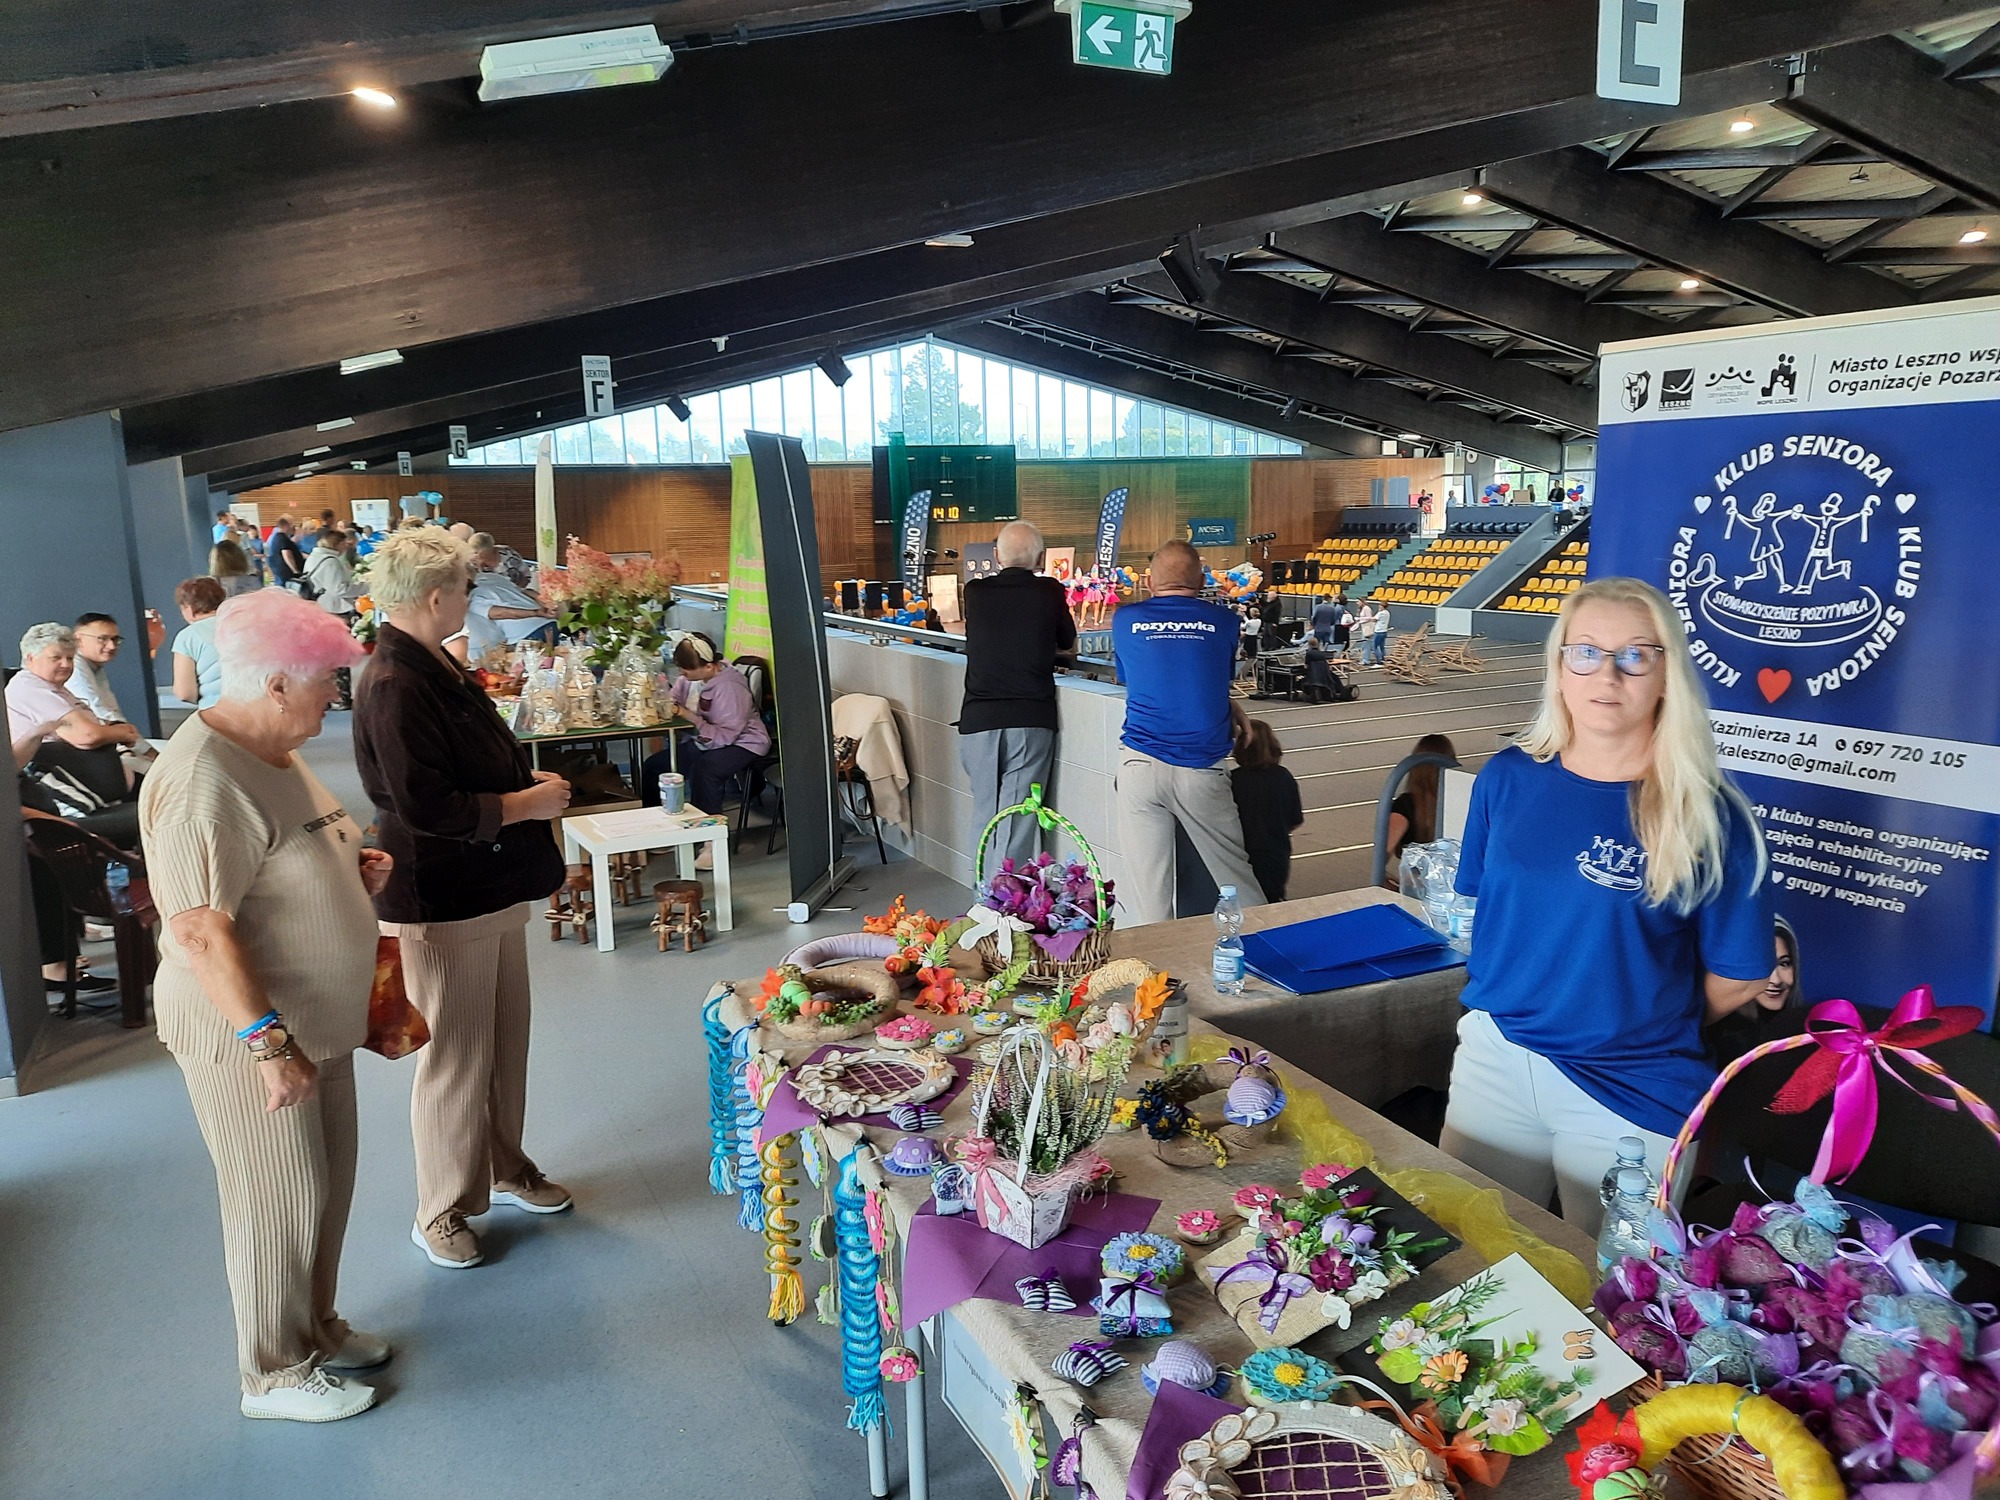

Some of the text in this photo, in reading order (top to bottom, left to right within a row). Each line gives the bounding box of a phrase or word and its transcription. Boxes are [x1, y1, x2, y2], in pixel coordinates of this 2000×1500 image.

[1619, 0, 1660, 87] E
[585, 369, 609, 377] SEKTOR
[1829, 356, 1888, 374] Miasto
[1895, 350, 1961, 369] Leszno
[591, 381, 605, 412] F
[1828, 371, 1932, 396] Organizacje
[1660, 400, 1692, 408] LESZNO
[456, 439, 465, 458] G
[1714, 435, 1893, 491] KLUB SENIORA
[401, 461, 410, 474] H
[1099, 522, 1117, 569] LESZNO
[1712, 591, 1869, 622] STOWARZYSZENIE POZYTYWKA
[1806, 526, 1922, 697] KLUB SENIORA
[1131, 621, 1216, 635] Pozytywka
[1758, 626, 1802, 640] LESZNO
[1689, 639, 1742, 688] KLUB
[1715, 741, 1897, 784] kaleszno@gmail.com
[1796, 732, 1818, 748] 1A
[1852, 740, 1886, 756] 697
[1890, 745, 1924, 763] 720
[1930, 750, 1968, 769] 105
[1765, 828, 1944, 876] zajęcia rehabilitacyjne
[1770, 806, 1815, 827] klubu
[1816, 819, 1875, 841] seniora
[1878, 830, 1991, 863] organizując:
[1771, 850, 1929, 898] szkolenia i wykłady
[1785, 874, 1907, 914] grupy wsparcia
